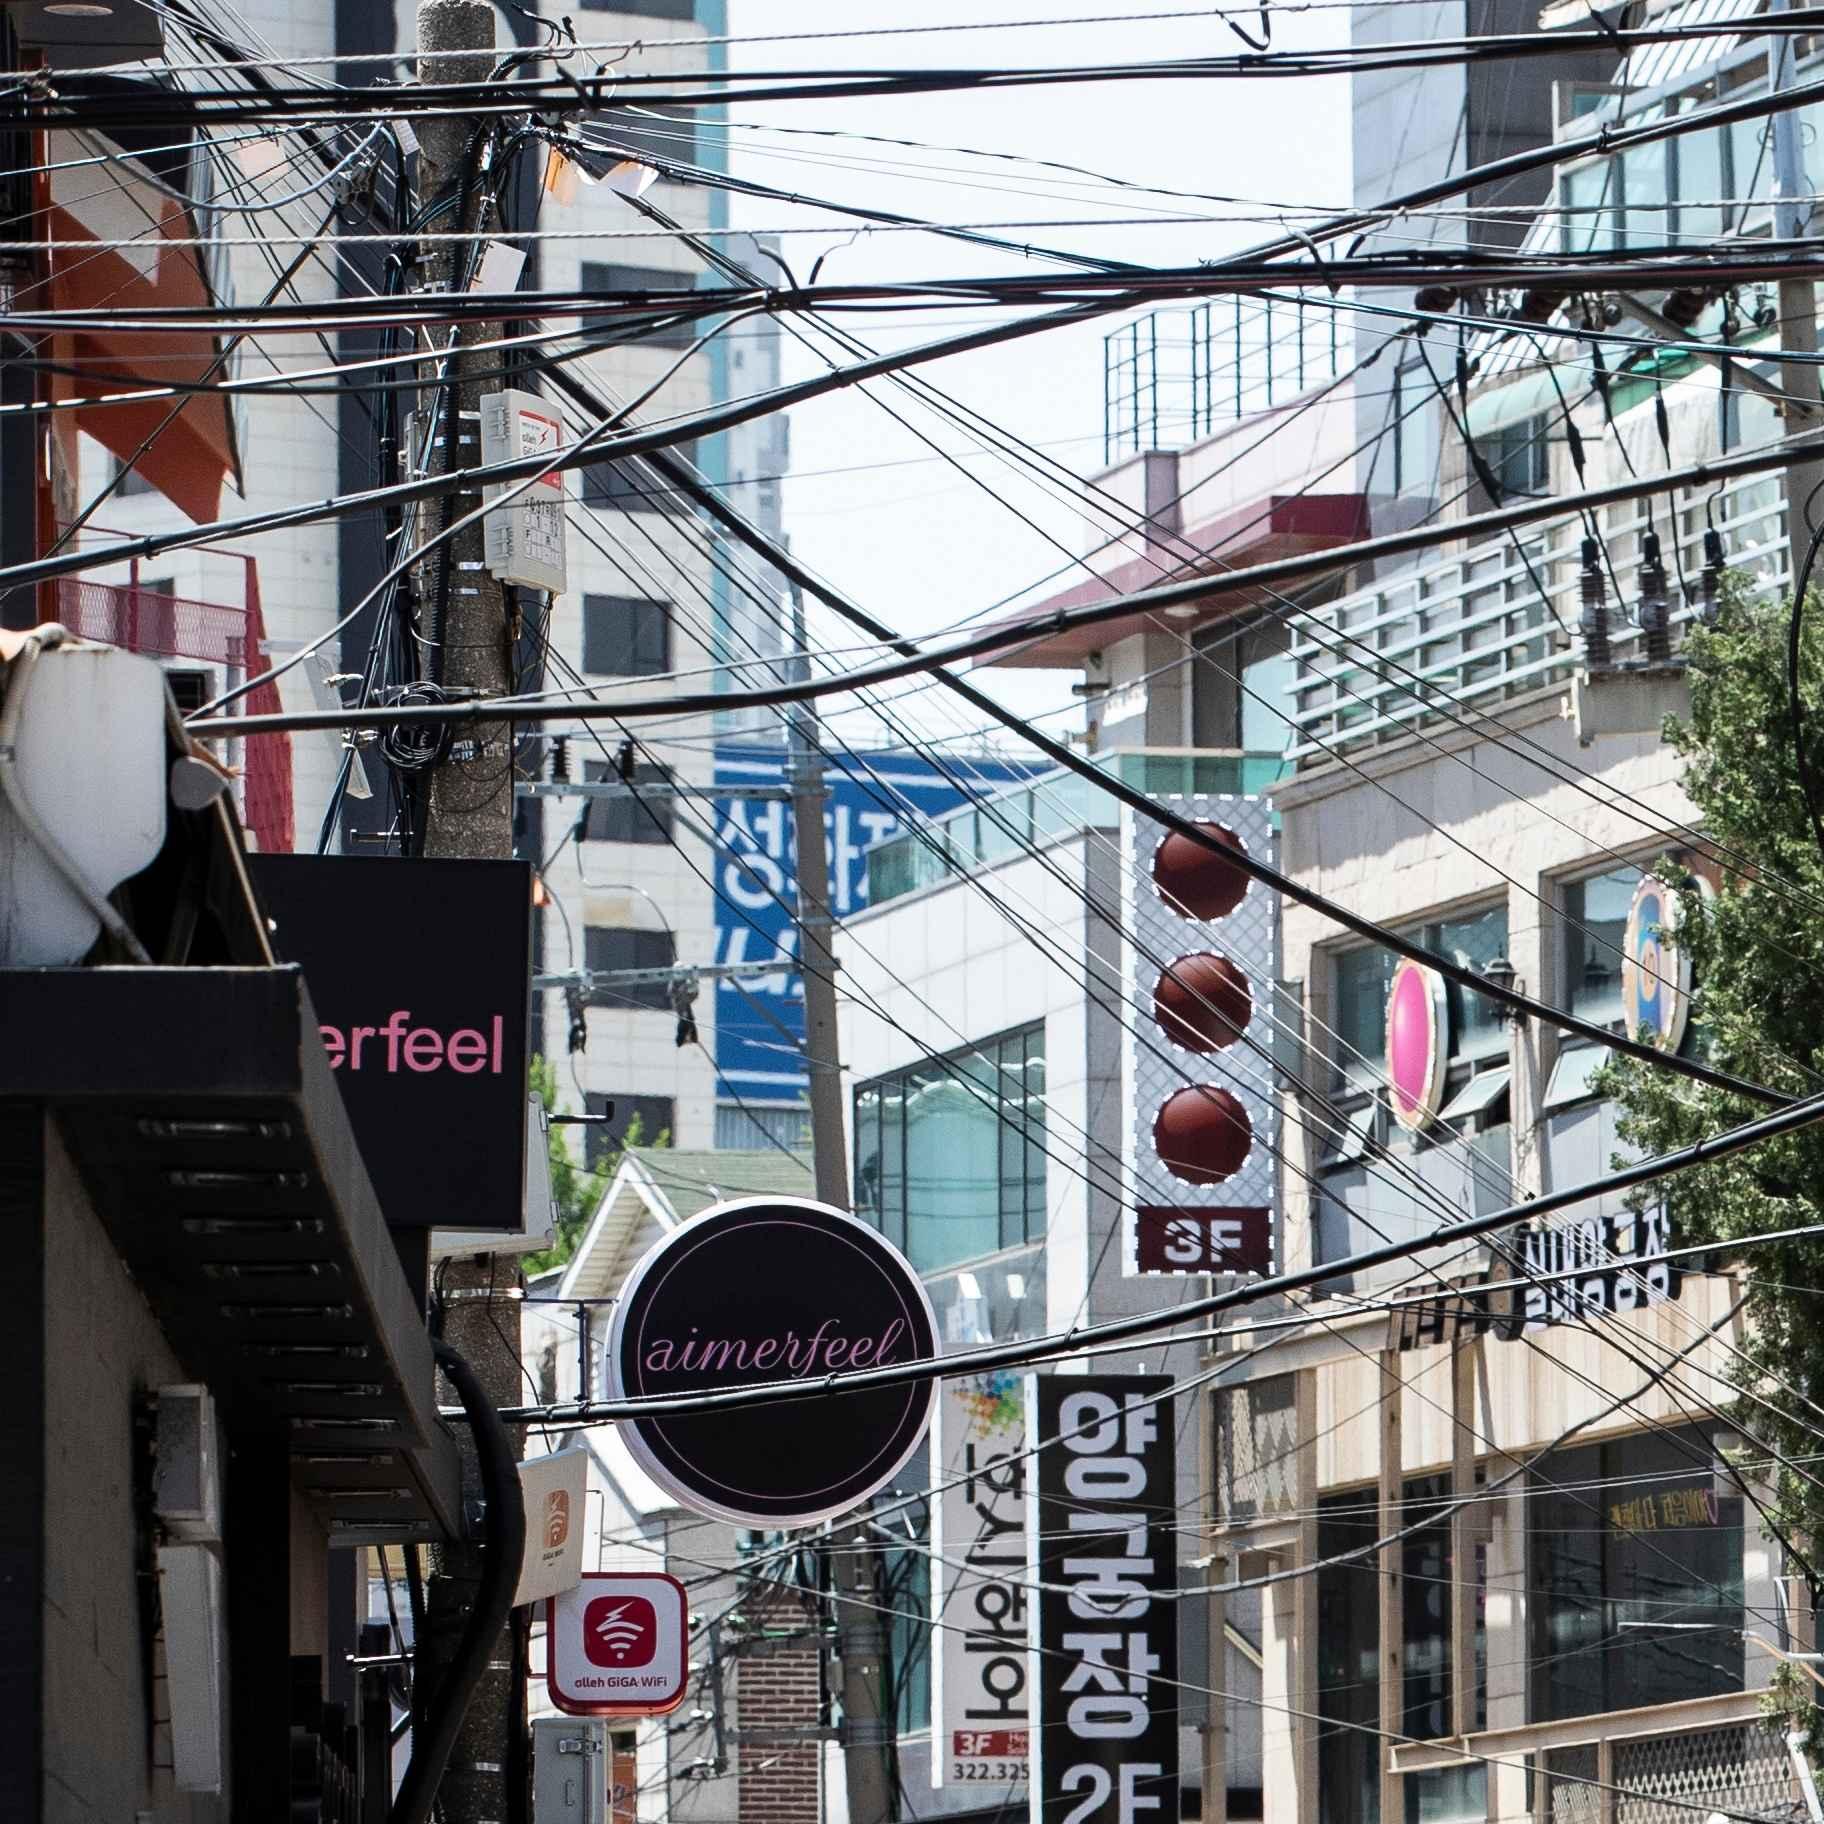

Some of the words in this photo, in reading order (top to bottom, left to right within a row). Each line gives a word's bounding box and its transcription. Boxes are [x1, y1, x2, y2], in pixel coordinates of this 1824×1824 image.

[1163, 1219, 1243, 1264] 3F
[645, 1316, 906, 1380] aimerfeel
[641, 1675, 668, 1688] WiFi
